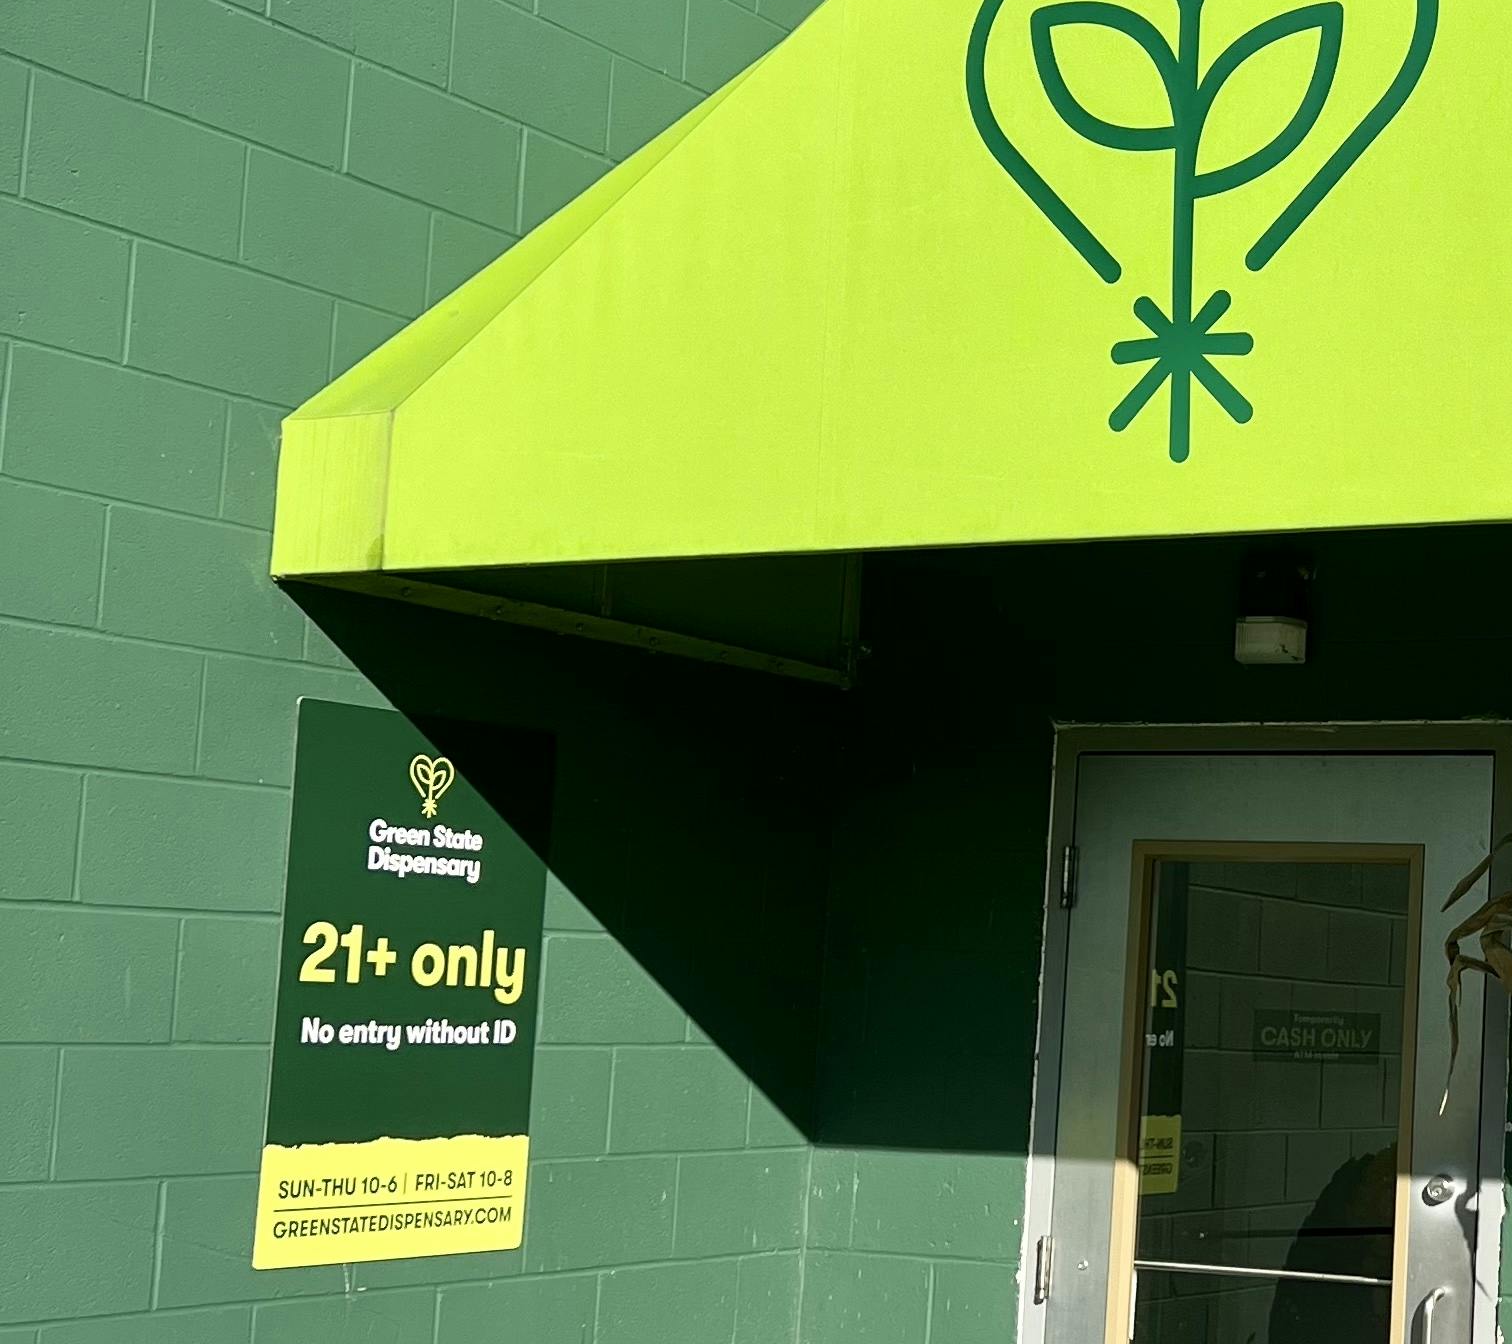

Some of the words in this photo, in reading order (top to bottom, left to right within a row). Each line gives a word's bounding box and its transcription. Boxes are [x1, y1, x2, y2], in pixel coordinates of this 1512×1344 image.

[368, 818, 431, 848] Green
[432, 824, 483, 852] State
[367, 845, 481, 884] Dispensary
[299, 921, 397, 984] 21+
[411, 929, 526, 1005] only
[300, 1016, 335, 1044] No
[338, 1020, 402, 1051] entry
[405, 1018, 490, 1045] without
[492, 1019, 517, 1044] ID
[1261, 1025, 1316, 1048] CASH
[1320, 1028, 1373, 1049] ONLY
[278, 1177, 357, 1200] SUN-THU
[361, 1175, 398, 1194] 10-6
[415, 1171, 476, 1192] FRI-SAT
[479, 1169, 513, 1187] 10-8
[273, 1206, 512, 1239] GREENSTATEDISPENSARY.COM
